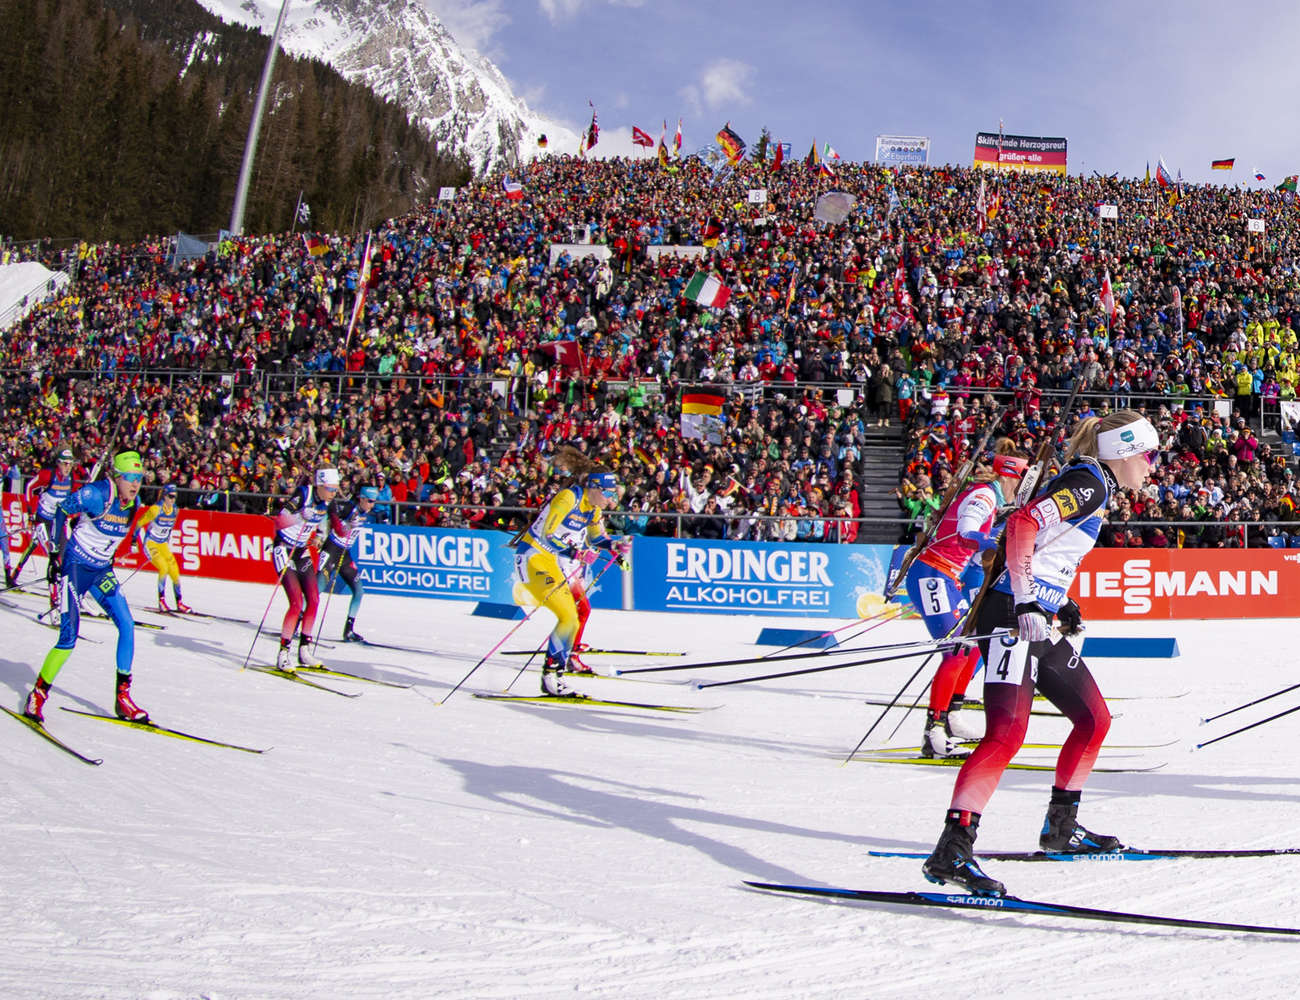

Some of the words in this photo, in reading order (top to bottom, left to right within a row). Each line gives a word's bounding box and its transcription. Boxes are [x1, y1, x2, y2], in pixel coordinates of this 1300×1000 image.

[357, 527, 494, 573] ERDINGER
[666, 543, 835, 587] ERDINGER
[358, 568, 490, 592] ALKOHOLFREI
[666, 585, 830, 606] ALKOHOLFREI
[1079, 559, 1279, 615] IESSMANN
[929, 592, 941, 614] 5
[996, 649, 1012, 681] 4
